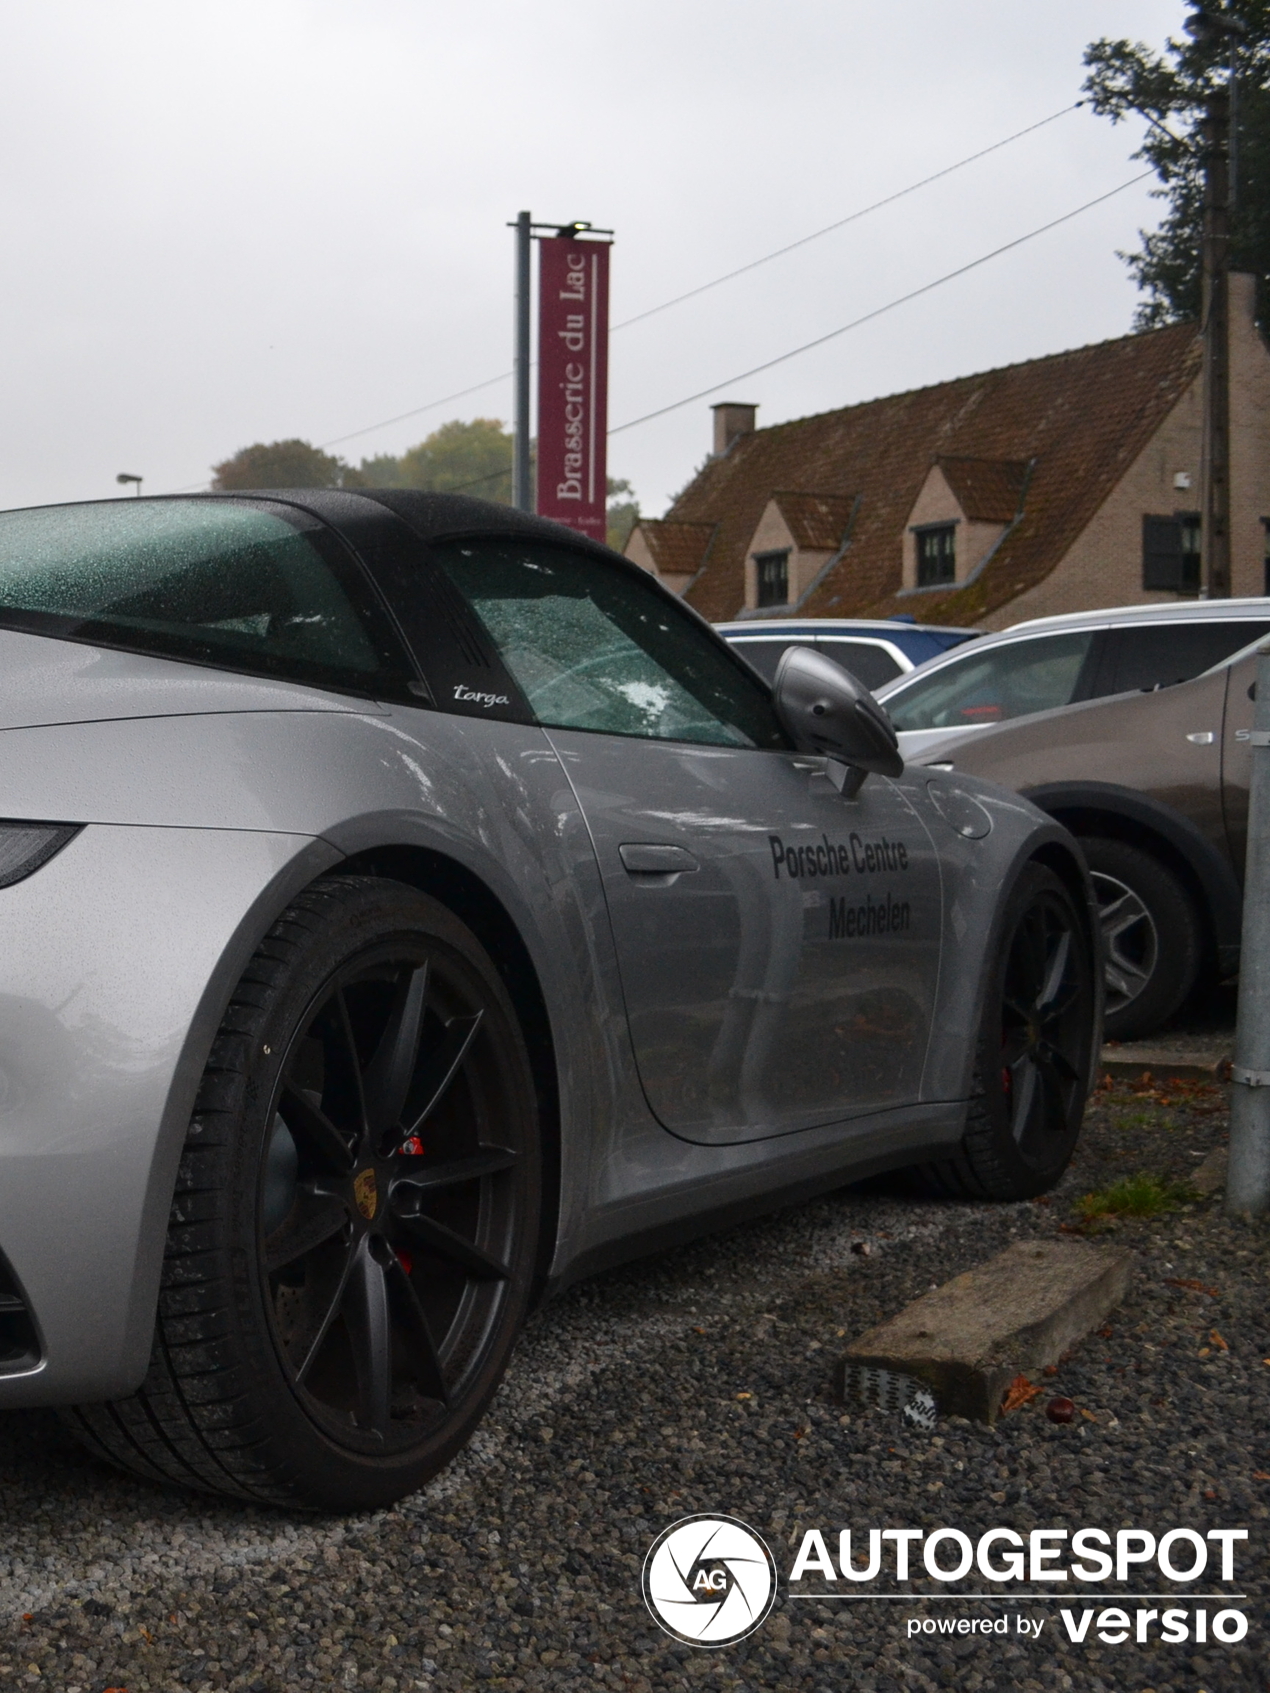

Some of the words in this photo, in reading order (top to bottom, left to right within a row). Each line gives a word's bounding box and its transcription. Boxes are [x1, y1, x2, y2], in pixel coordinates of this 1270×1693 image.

[559, 253, 587, 301] Lac
[557, 315, 585, 352] du
[557, 362, 584, 502] Brasserie
[453, 684, 510, 708] targa
[768, 833, 849, 879] Porsche
[849, 832, 909, 874] Centre
[828, 892, 910, 940] Mechelen
